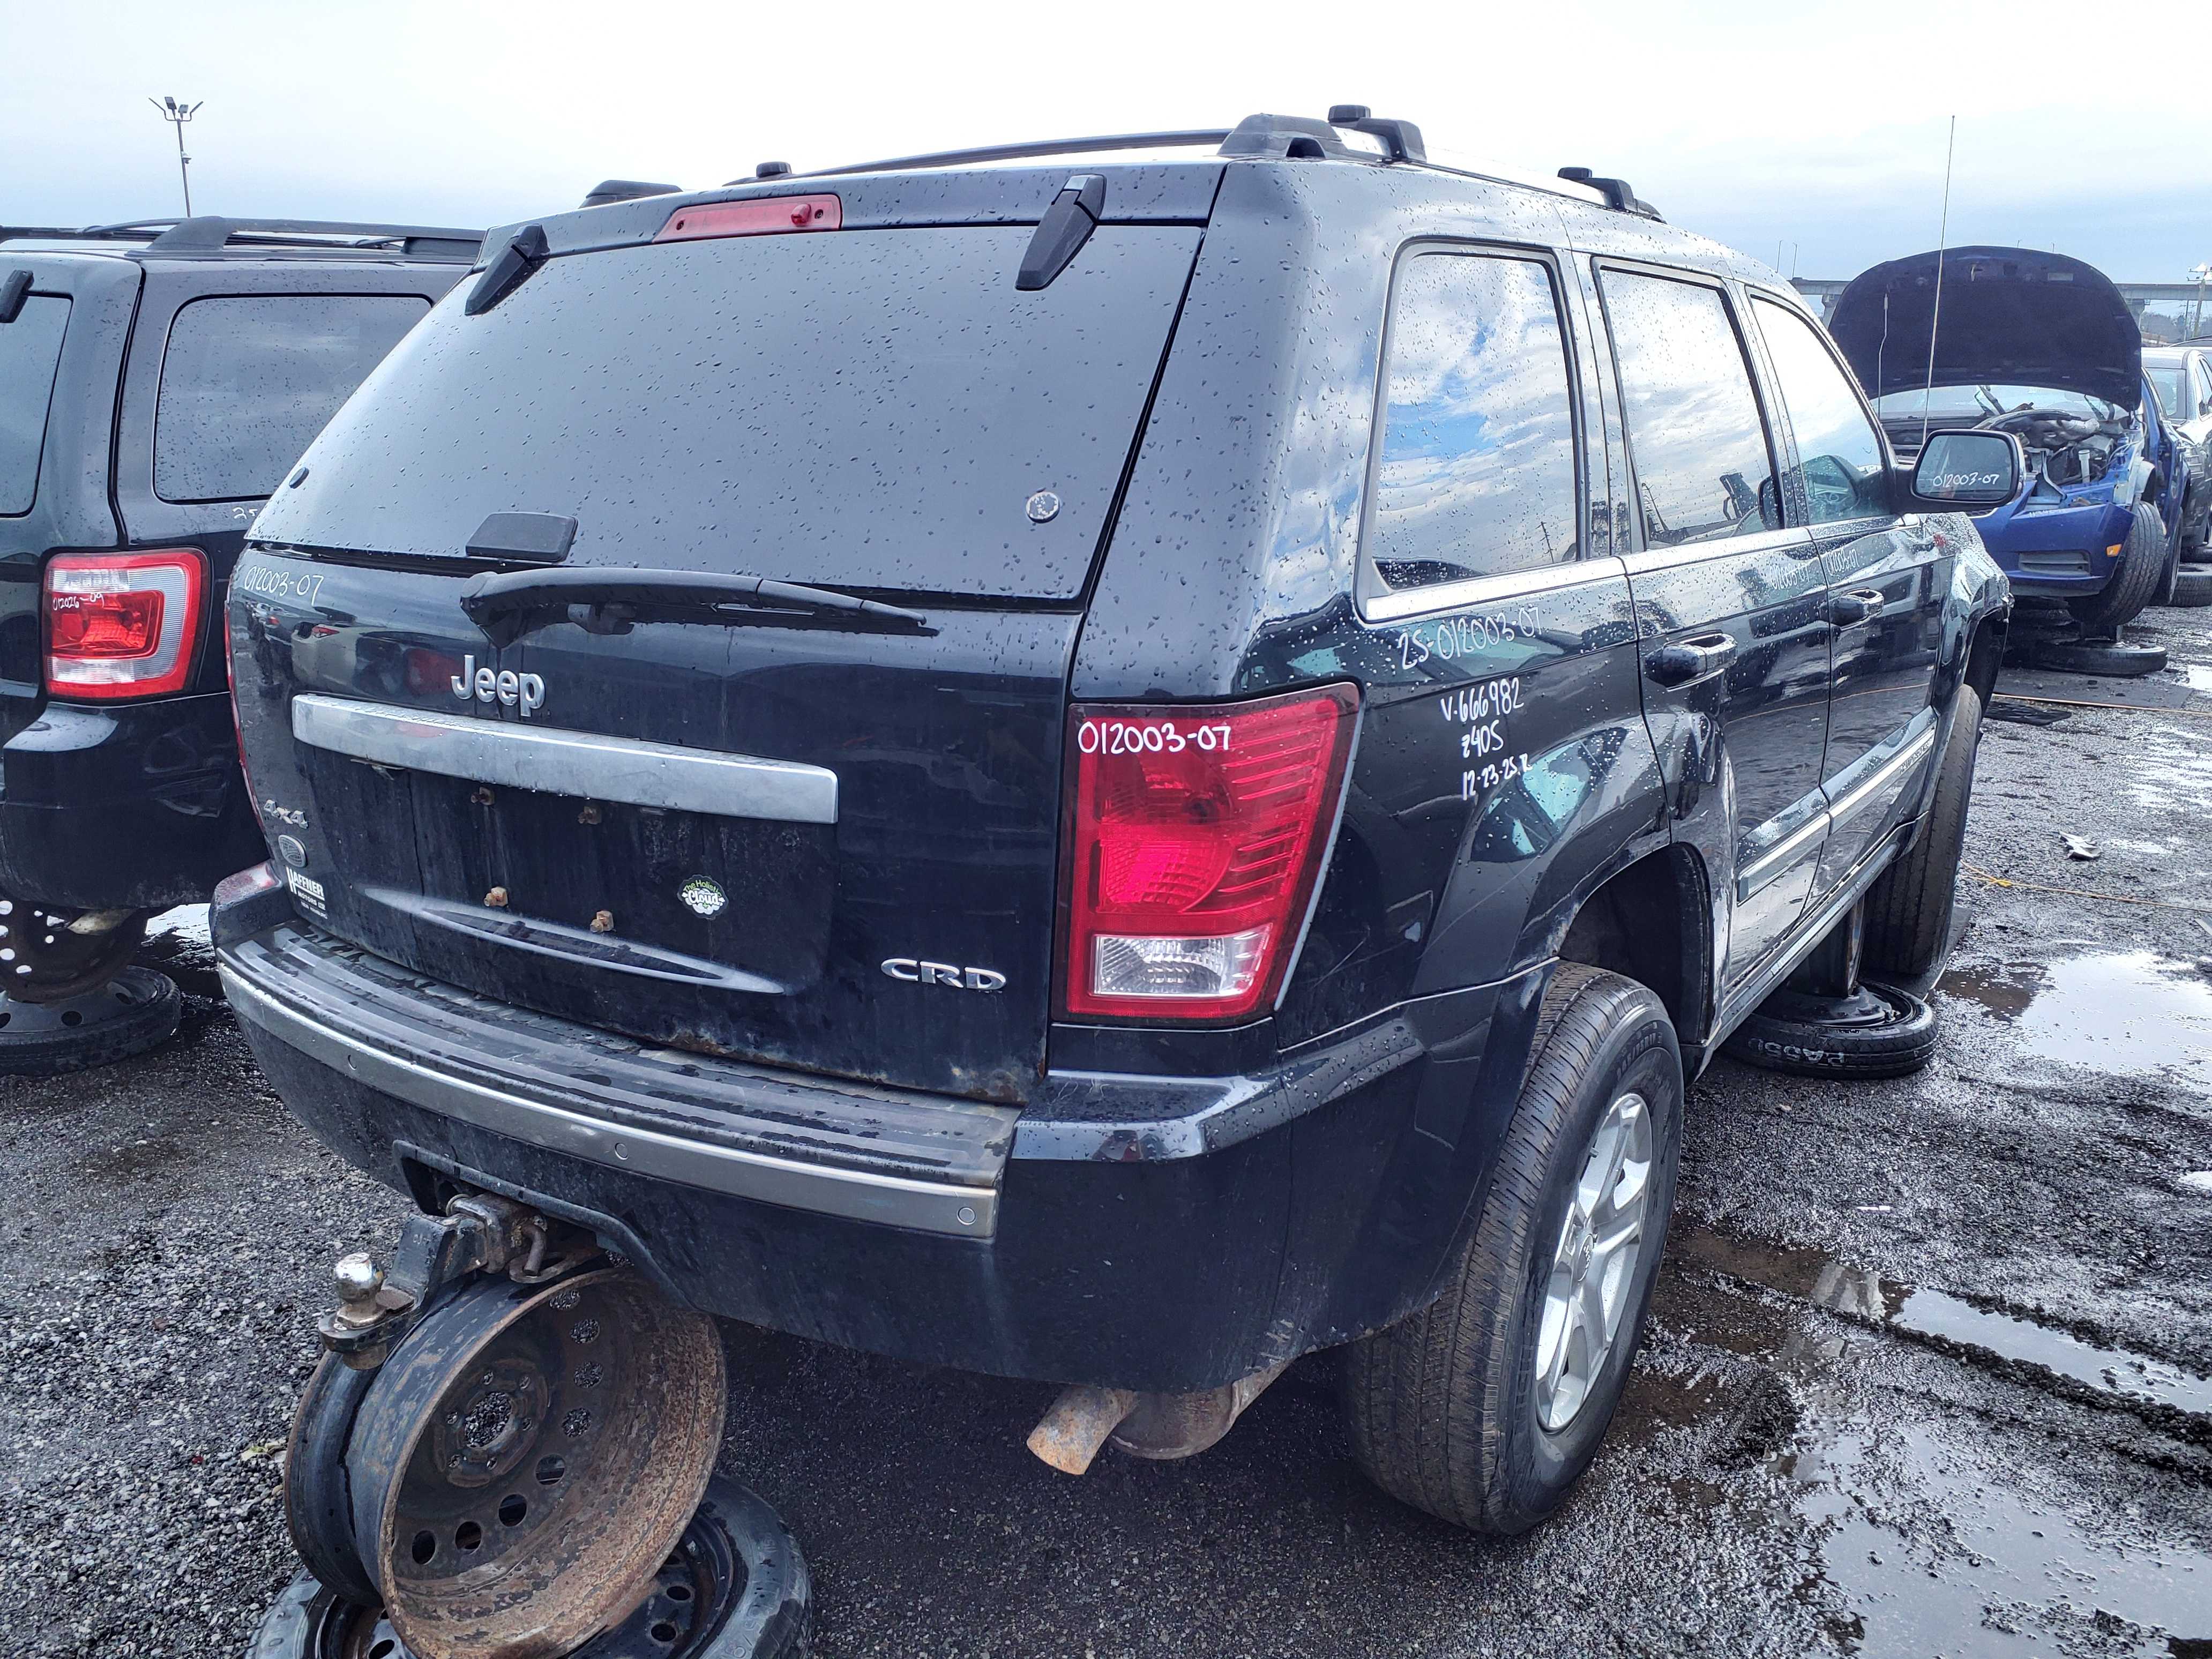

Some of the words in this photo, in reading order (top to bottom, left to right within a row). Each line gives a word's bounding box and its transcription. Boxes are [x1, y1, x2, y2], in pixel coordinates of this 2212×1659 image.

[1932, 472, 2000, 488] 012003-07
[244, 565, 324, 606] 012003-07
[53, 592, 104, 611] 012026-09
[1397, 607, 1541, 670] 25-012003-07
[451, 654, 545, 717] Jeep
[1078, 721, 1231, 754] 012003-07
[286, 866, 325, 897] HAFFNER
[683, 882, 696, 893] The
[696, 879, 722, 898] Holistic
[687, 890, 720, 906] Cloud
[880, 958, 1006, 990] CRD
